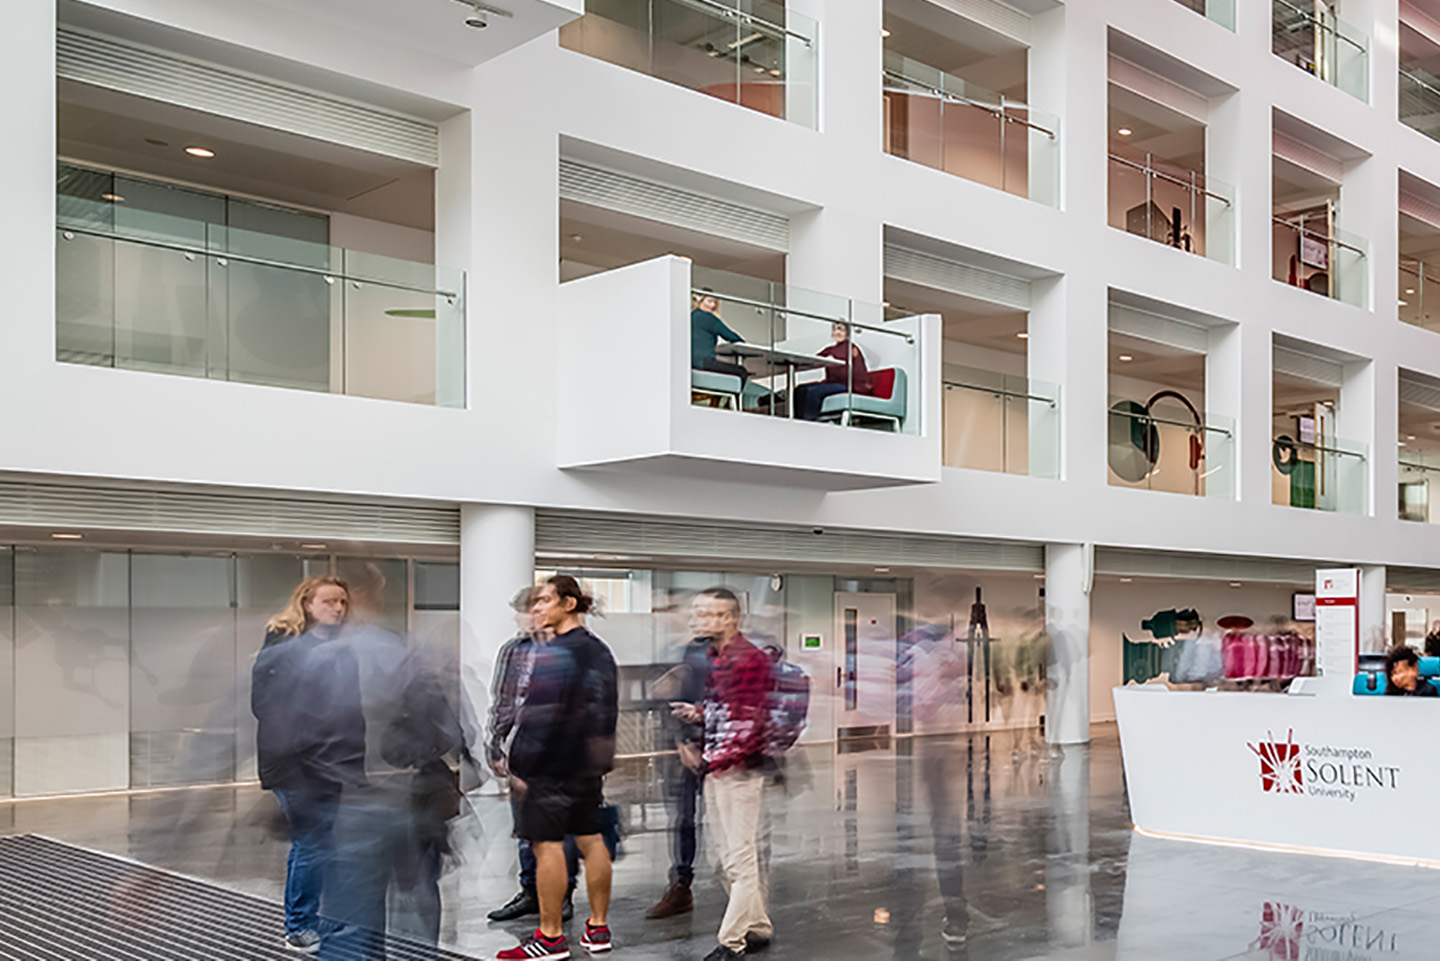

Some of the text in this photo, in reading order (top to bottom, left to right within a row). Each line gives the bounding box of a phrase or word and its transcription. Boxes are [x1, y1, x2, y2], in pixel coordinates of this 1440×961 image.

[1305, 744, 1372, 761] Southampton
[1306, 758, 1400, 789] SOLENT
[1308, 786, 1356, 802] University
